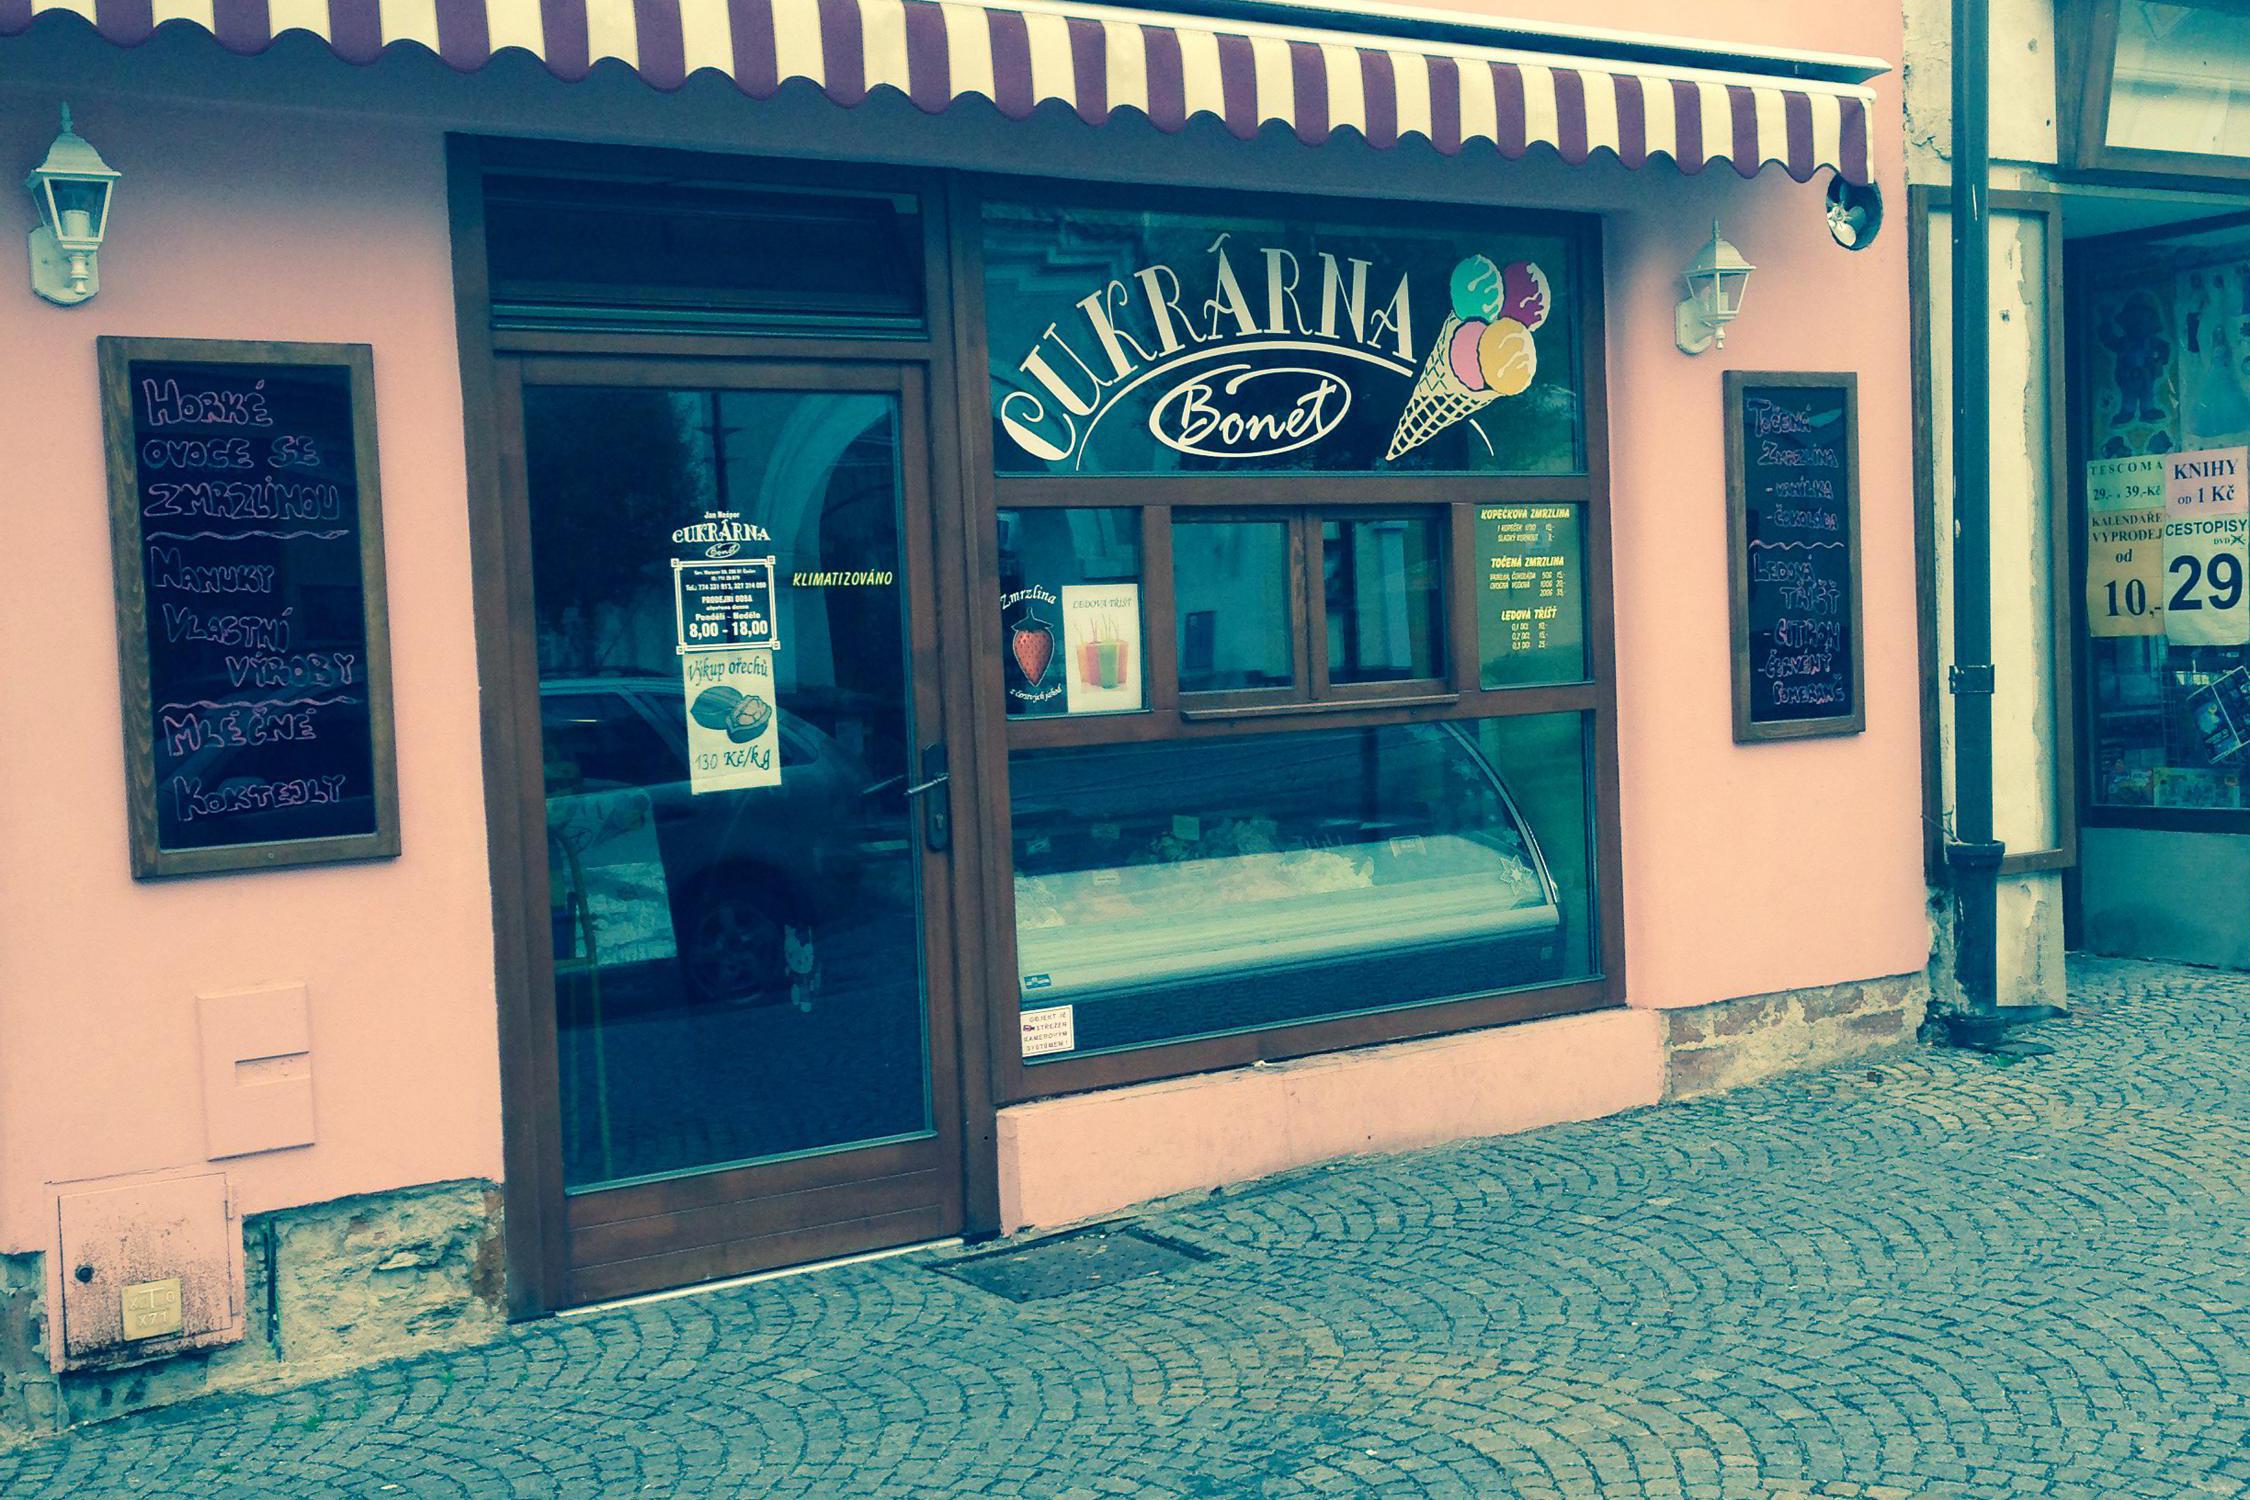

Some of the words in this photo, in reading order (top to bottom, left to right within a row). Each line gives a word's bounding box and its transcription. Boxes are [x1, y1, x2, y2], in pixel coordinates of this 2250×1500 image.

[1000, 233, 1417, 461] CUKRÁRNA
[142, 379, 273, 426] HORKÉ
[1178, 378, 1337, 446] Bonet
[2090, 461, 2163, 476] TESCOMA
[2174, 459, 2238, 480] KNIHY
[2177, 496, 2192, 505] OD
[2198, 487, 2204, 503] 1
[2212, 484, 2235, 502] Kč
[1530, 508, 1570, 519] ZMRZLINA
[672, 519, 772, 543] CUKRÁRNA
[2165, 519, 2248, 537] CESTOPISY
[1491, 554, 1522, 569] TOČENÁ
[1525, 556, 1564, 567] ZMRZLINA
[2115, 549, 2132, 563] od
[150, 546, 275, 593] NANUKY
[792, 568, 893, 587] KLIMATIZOVÁNO
[2168, 553, 2243, 611] 29
[1000, 584, 1057, 611] Zmrzlina
[1501, 607, 1531, 621] LEDOVÁ
[689, 622, 719, 640] 8,00
[731, 620, 769, 638] 18,00
[723, 744, 771, 771] Kč/kg
